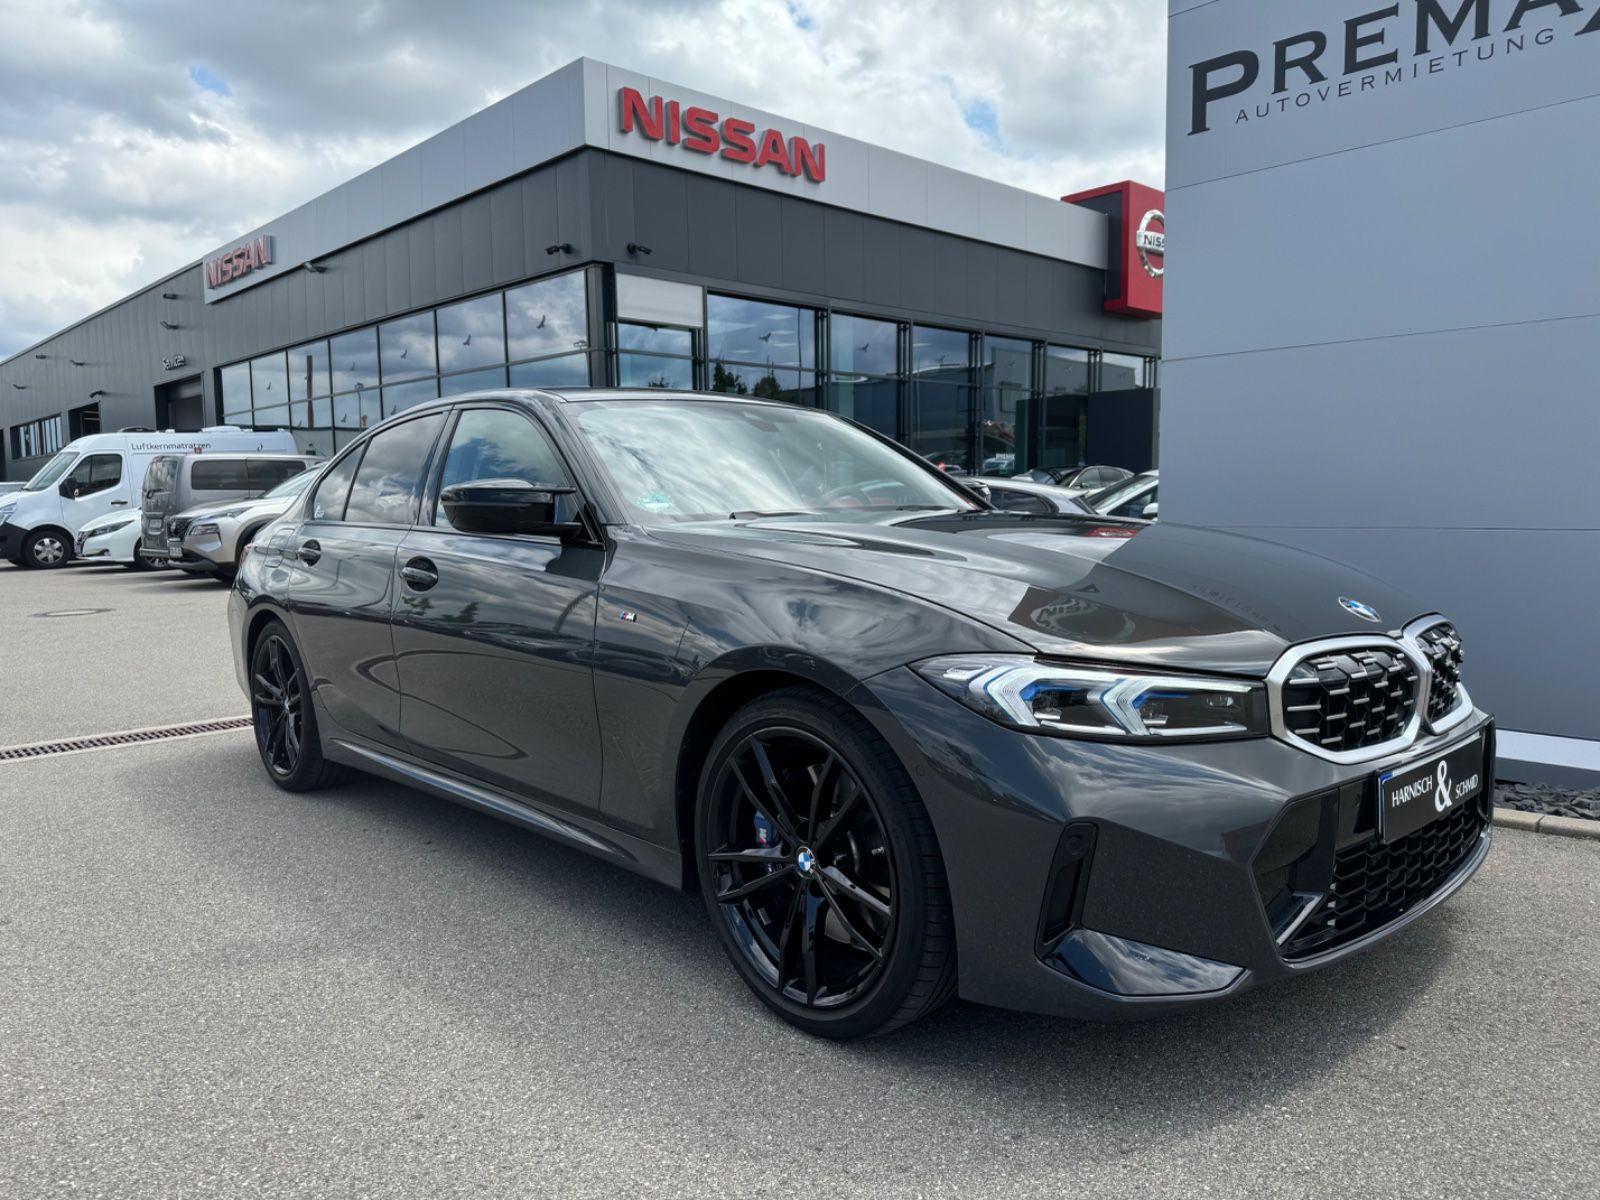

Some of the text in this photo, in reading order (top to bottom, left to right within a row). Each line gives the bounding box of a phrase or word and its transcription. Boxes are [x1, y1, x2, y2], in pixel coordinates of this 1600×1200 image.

[1187, 0, 1600, 136] PREM
[1235, 28, 1554, 124] AUTOVERMIETUNG
[618, 86, 826, 183] NISSAN
[206, 234, 272, 289] NISSAN
[131, 442, 212, 451] Luftkernmatratzen
[1392, 760, 1479, 812] HARNISCH & SCHMID
